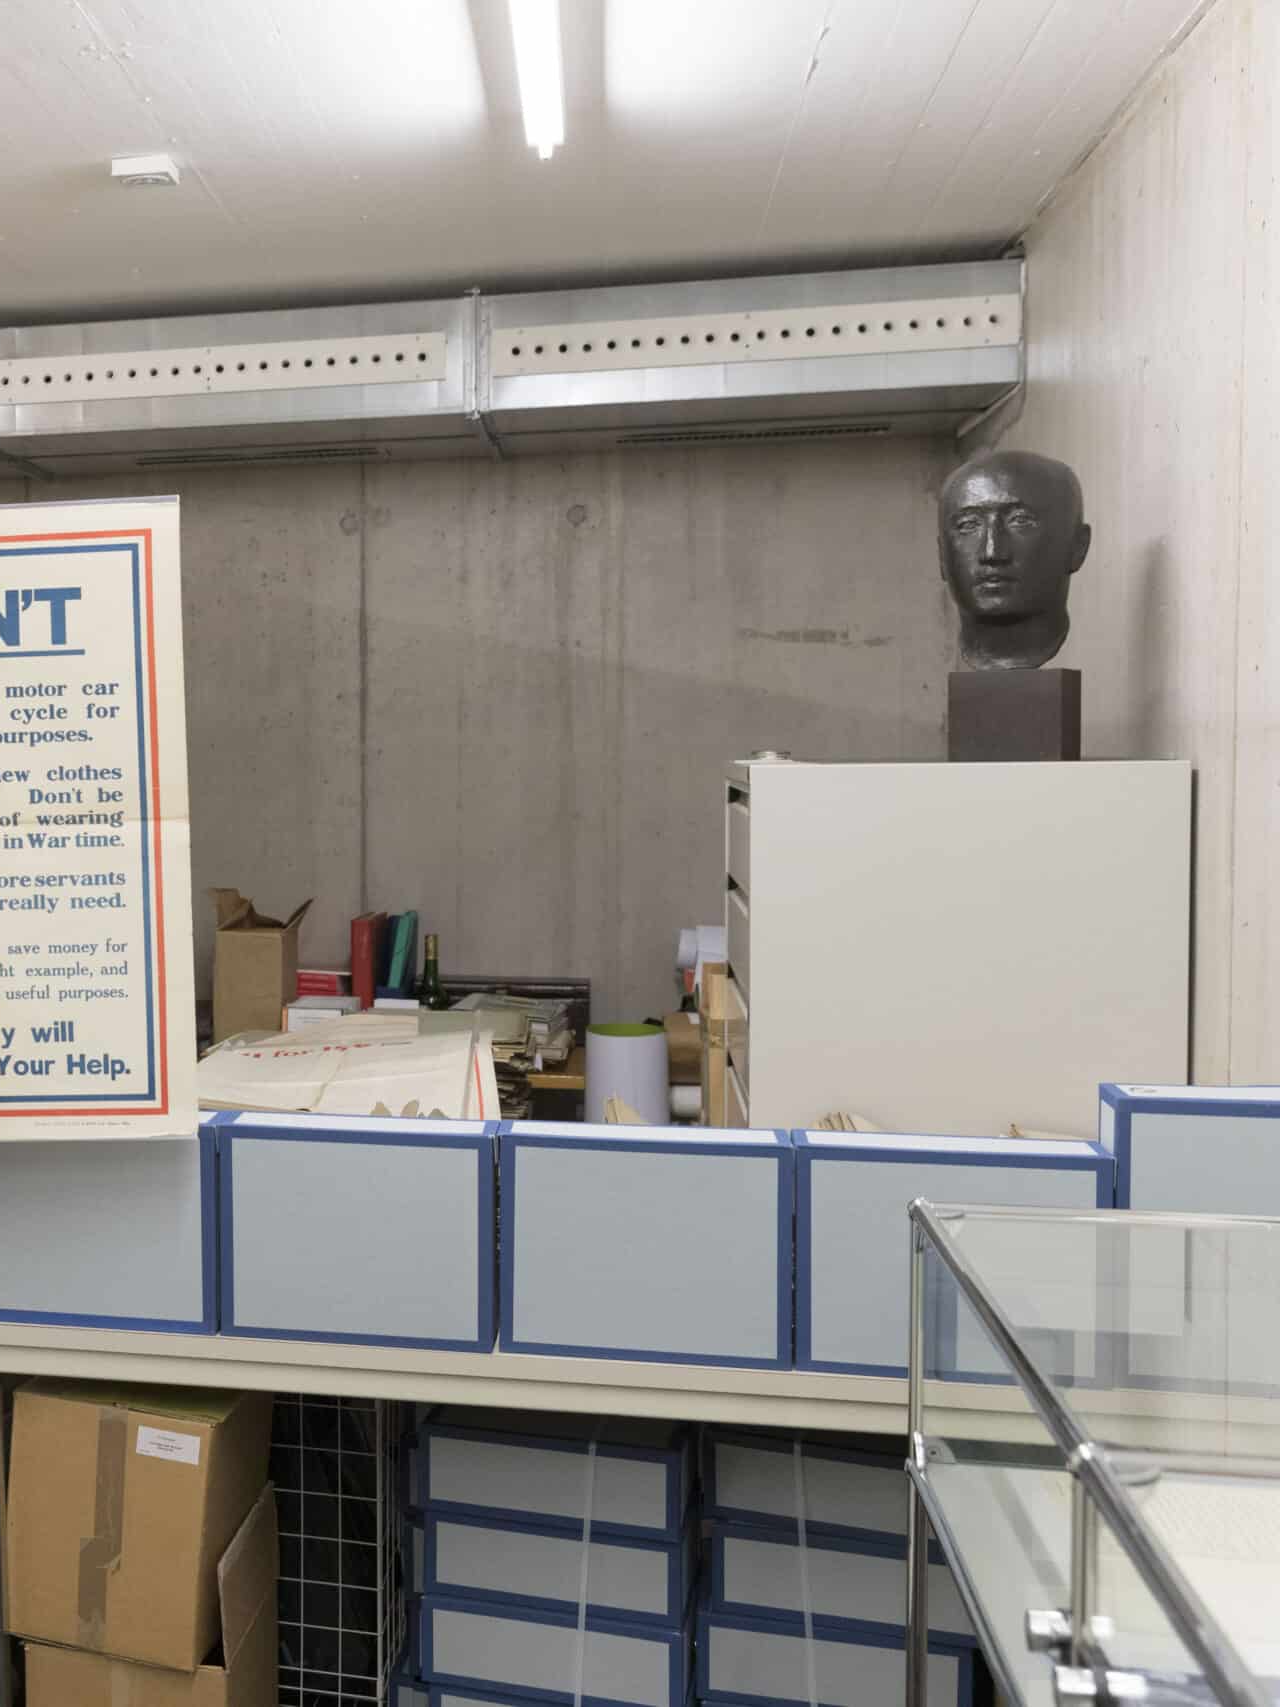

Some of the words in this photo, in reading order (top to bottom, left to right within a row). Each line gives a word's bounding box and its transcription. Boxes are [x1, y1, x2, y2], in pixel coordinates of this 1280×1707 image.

[5, 682, 68, 699] motor
[81, 682, 120, 696] car
[9, 703, 68, 725] cycle
[85, 702, 121, 720] for
[46, 764, 123, 782] clothes
[28, 787, 84, 805] Don't
[97, 786, 124, 804] be
[35, 809, 125, 829] wearing
[2, 833, 24, 850] in
[26, 832, 72, 849] War
[74, 831, 125, 849] time.
[33, 871, 127, 888] servants
[69, 891, 127, 910] need.
[7, 944, 41, 955] save
[47, 943, 99, 957] money
[105, 937, 129, 953] for
[24, 960, 94, 980] example,
[99, 959, 129, 977] and
[4, 983, 51, 1001] useful
[57, 988, 129, 1003] purposes.
[30, 1020, 75, 1044] will
[65, 1052, 132, 1082] Help.
